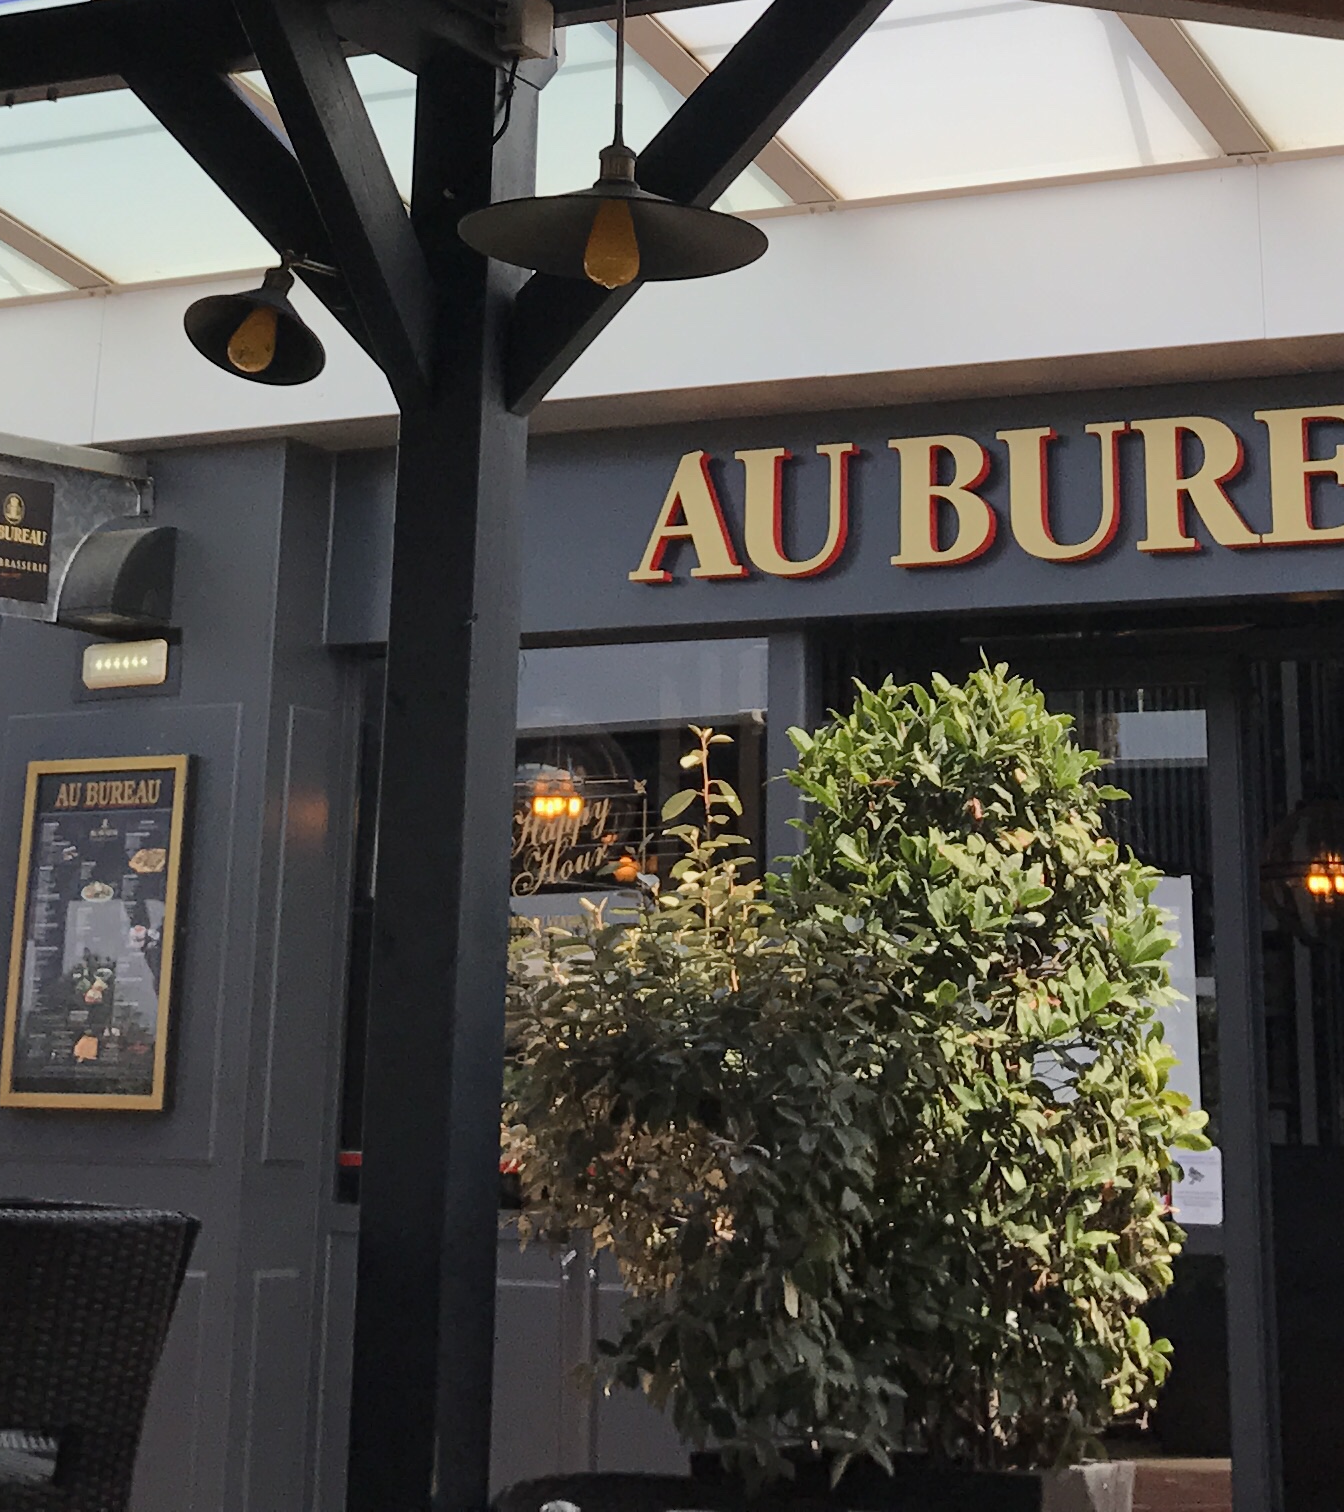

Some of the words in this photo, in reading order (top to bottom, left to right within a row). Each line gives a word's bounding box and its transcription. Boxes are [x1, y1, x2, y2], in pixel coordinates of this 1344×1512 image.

[628, 440, 856, 585] AU
[54, 781, 82, 807] AU
[84, 778, 162, 808] BUREAU
[512, 834, 609, 897] Hour
